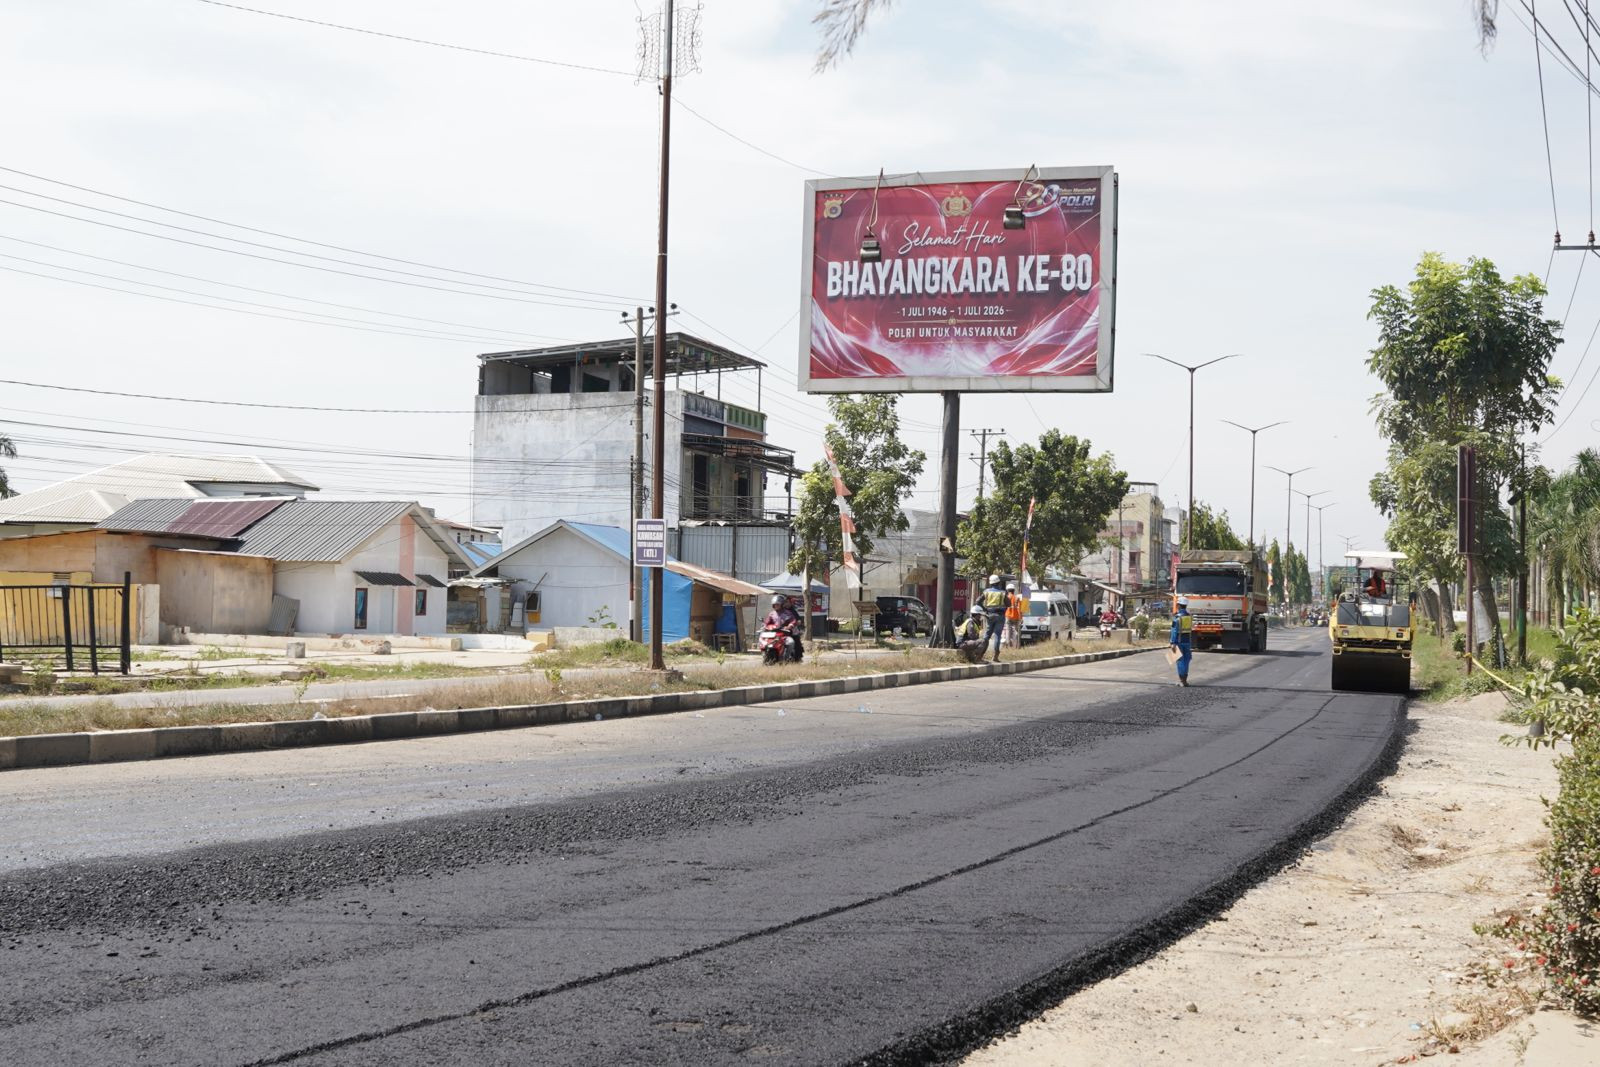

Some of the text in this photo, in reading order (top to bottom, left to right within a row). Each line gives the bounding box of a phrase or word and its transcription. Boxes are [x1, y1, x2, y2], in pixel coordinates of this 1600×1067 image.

[1060, 195, 1096, 206] POLRI
[898, 220, 1006, 254] Selamat Hari
[827, 253, 1092, 297] BHAYANGKARA KE-80
[901, 307, 906, 317] 1
[908, 307, 925, 317] JULI
[927, 306, 948, 316] 1946
[957, 306, 962, 315] 1
[964, 306, 981, 316] JULI
[983, 305, 1005, 316] 2026
[888, 326, 1018, 338] POLRI UNTUK MASYARAKAT
